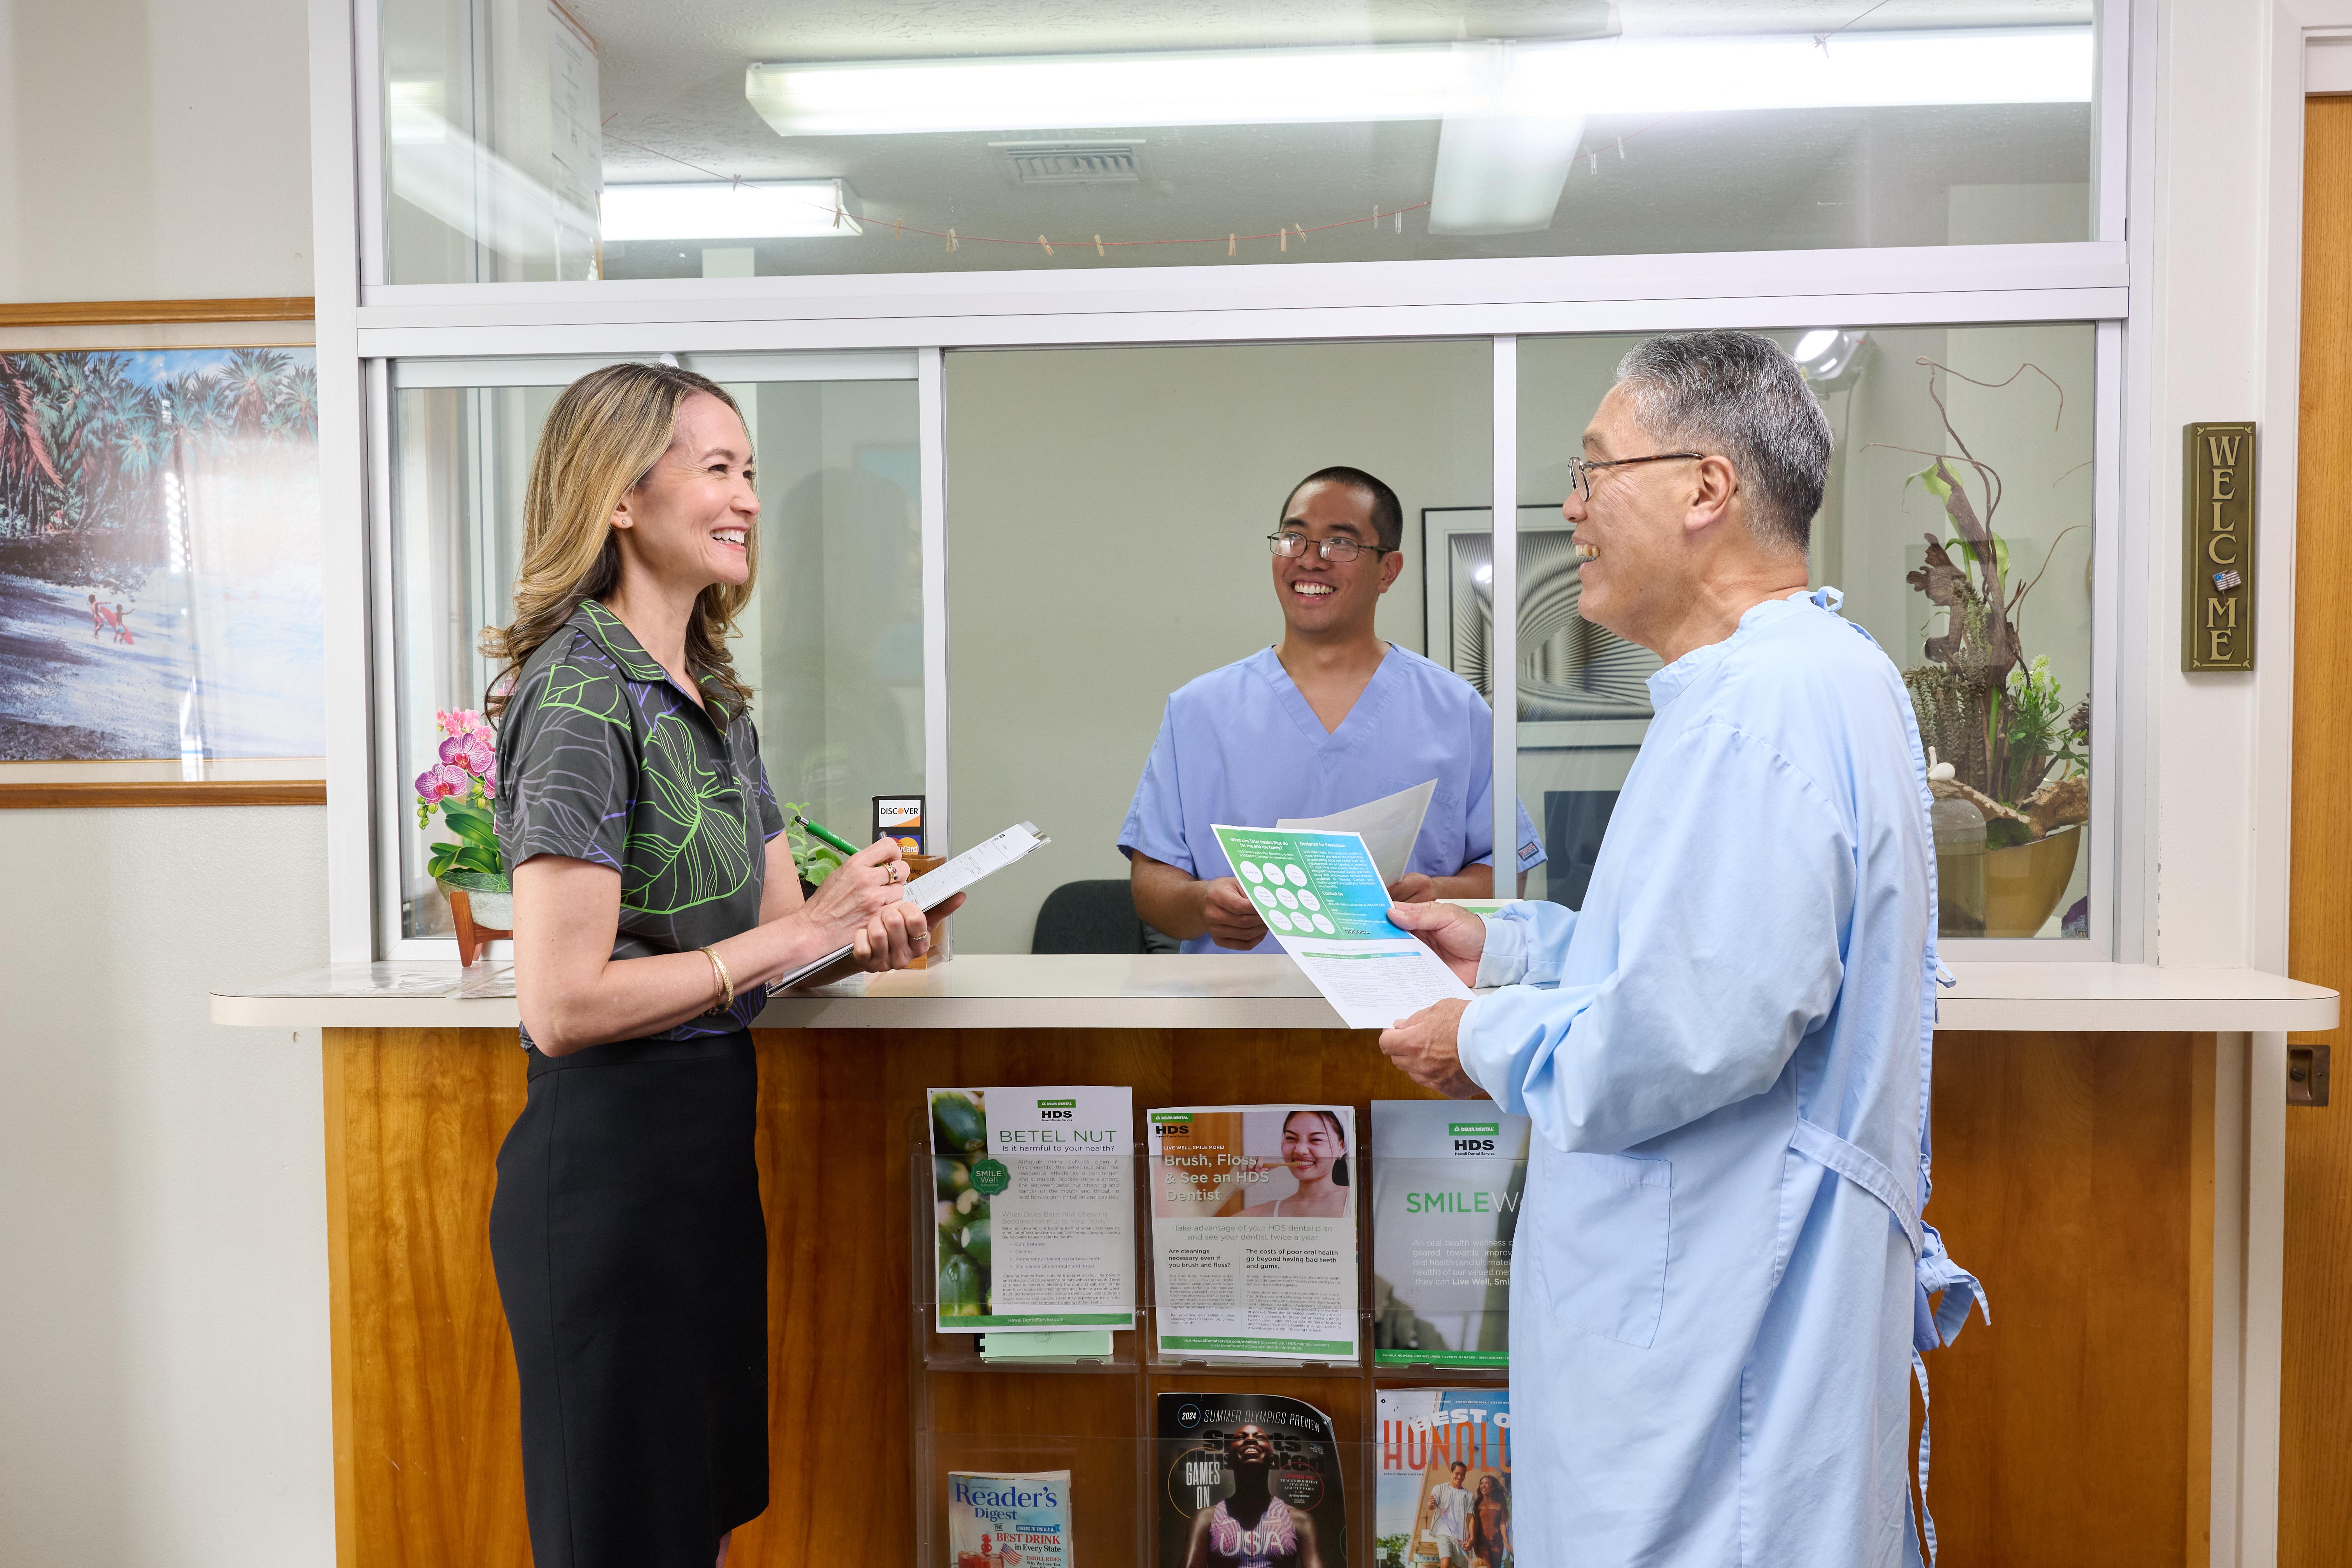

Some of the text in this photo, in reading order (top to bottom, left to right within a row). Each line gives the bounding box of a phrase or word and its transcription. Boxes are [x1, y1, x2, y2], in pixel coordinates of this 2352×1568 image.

[2207, 436, 2242, 660] WELCME
[1000, 1130, 1116, 1142] BETEL NUT
[1156, 1125, 1189, 1134] HDS
[1454, 1140, 1494, 1150] HDS
[1165, 1154, 1256, 1167] Brush, Floss
[1166, 1171, 1269, 1184] & See an HDS
[1167, 1189, 1221, 1201] Dentist
[1204, 1410, 1320, 1433] SUMMER OLYMPICS PREVIEW
[1409, 1409, 1487, 1434] BEST
[1186, 1461, 1220, 1485] GAMES
[955, 1483, 1057, 1508] Reader's
[1197, 1486, 1210, 1509] ON
[975, 1507, 1017, 1522] Digest
[996, 1533, 1061, 1544] BEST DRINK
[1220, 1531, 1284, 1556] USA
[1023, 1544, 1042, 1553] Every
